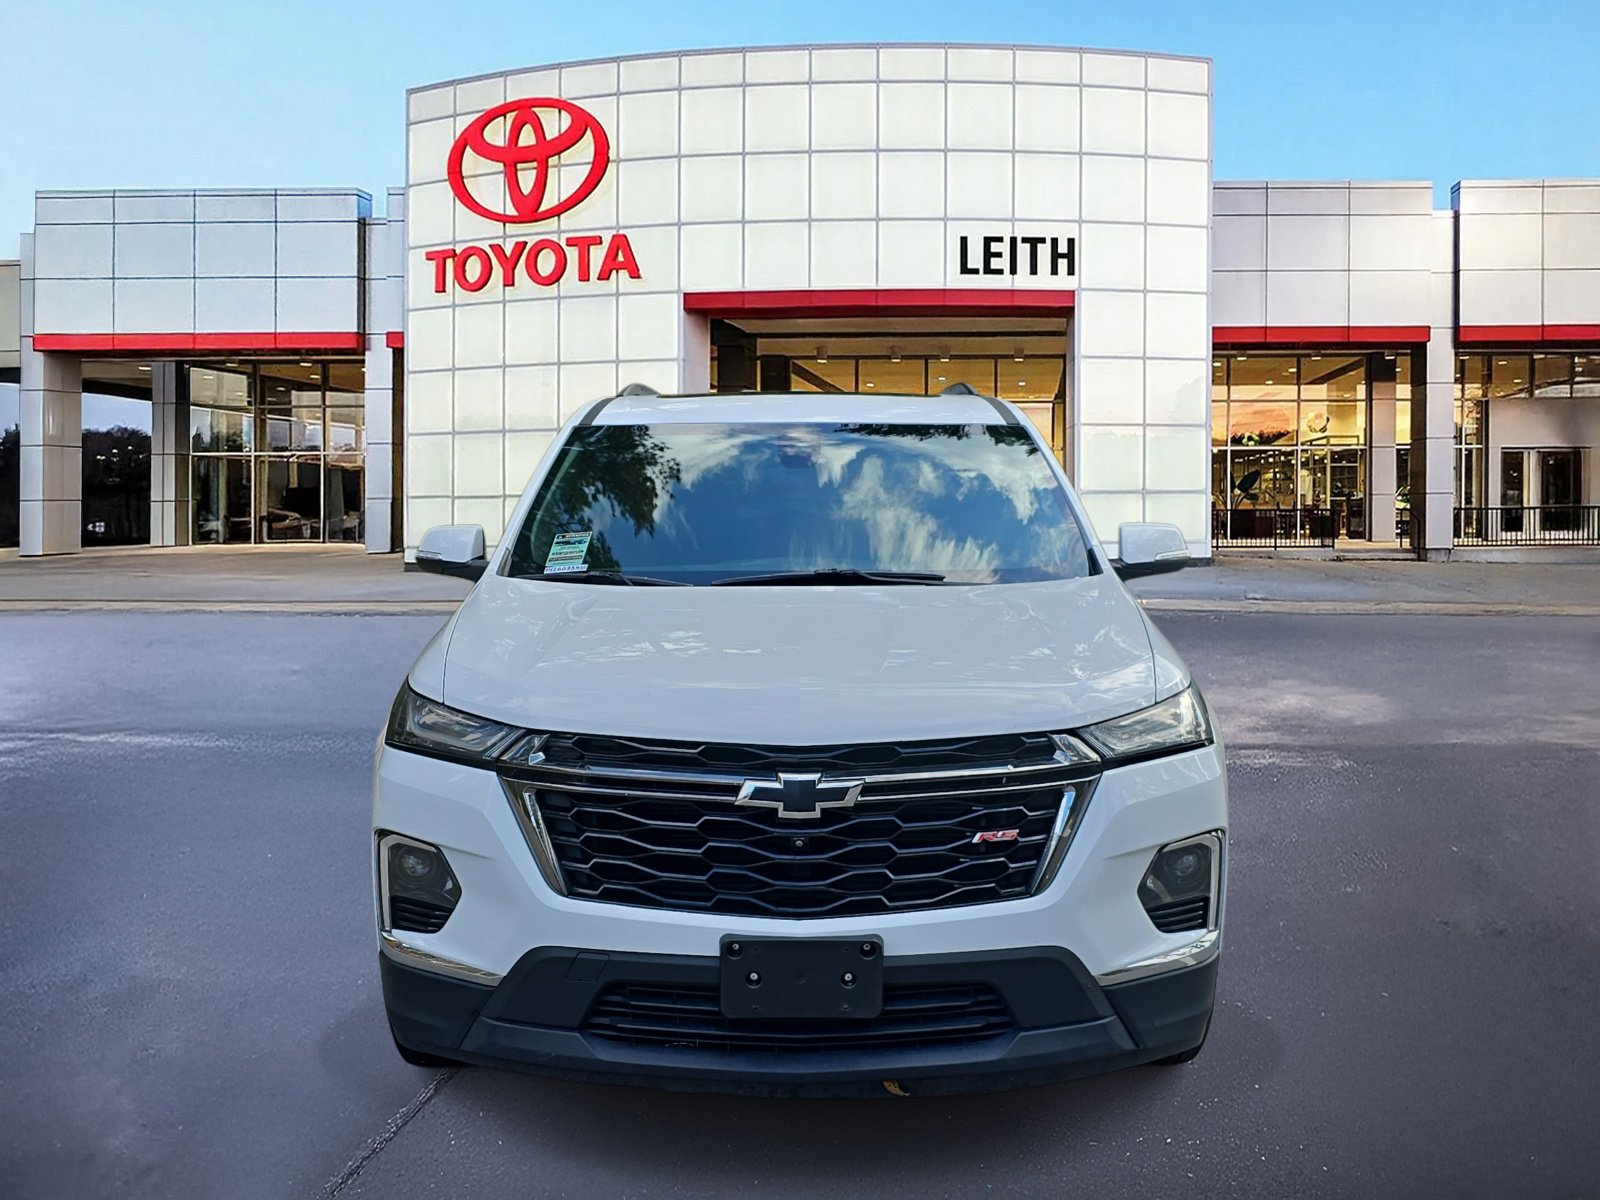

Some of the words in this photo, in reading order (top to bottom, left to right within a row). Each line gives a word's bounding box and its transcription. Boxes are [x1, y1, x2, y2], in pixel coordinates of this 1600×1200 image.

[426, 233, 641, 294] TOYOTA
[959, 236, 1076, 276] LEITH
[972, 829, 1019, 843] RS
